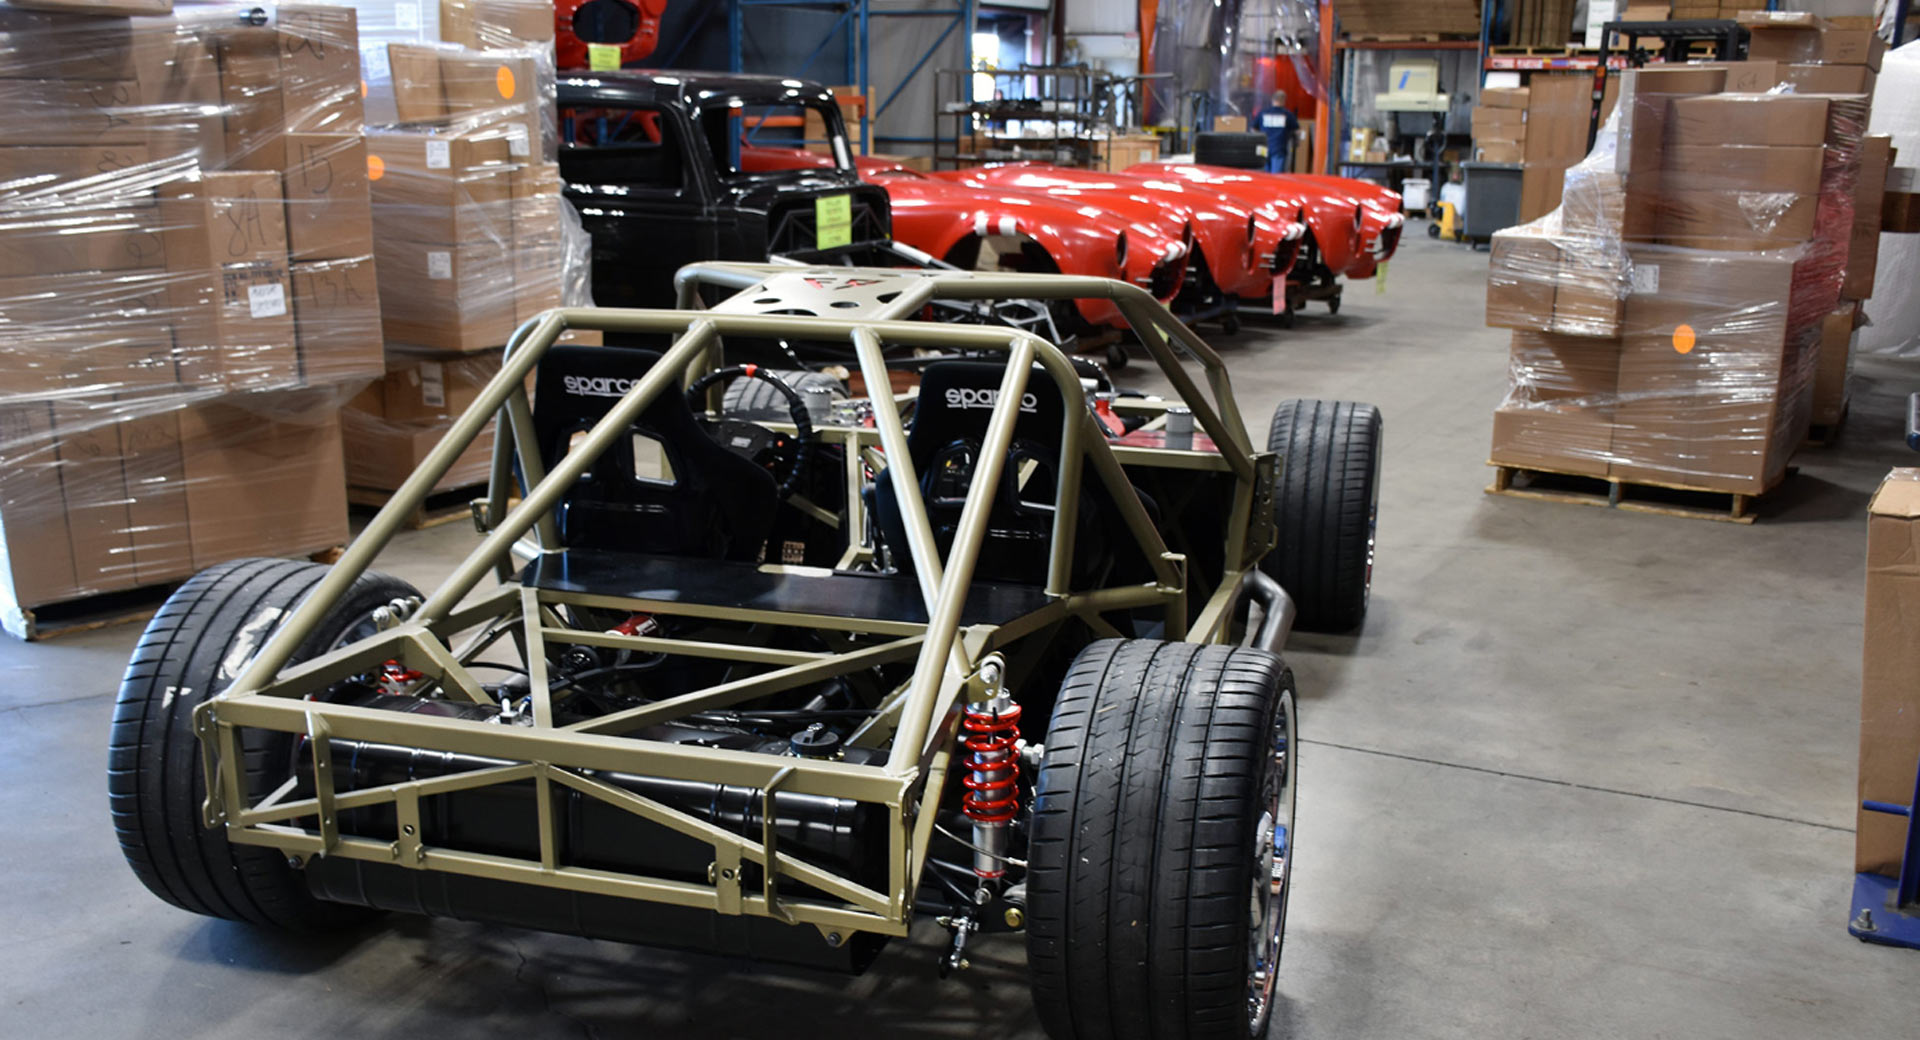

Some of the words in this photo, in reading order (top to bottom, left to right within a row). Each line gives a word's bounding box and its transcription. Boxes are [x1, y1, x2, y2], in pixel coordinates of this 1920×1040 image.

[300, 143, 334, 195] 15
[564, 375, 642, 397] sparc
[945, 388, 1038, 412] sparo
